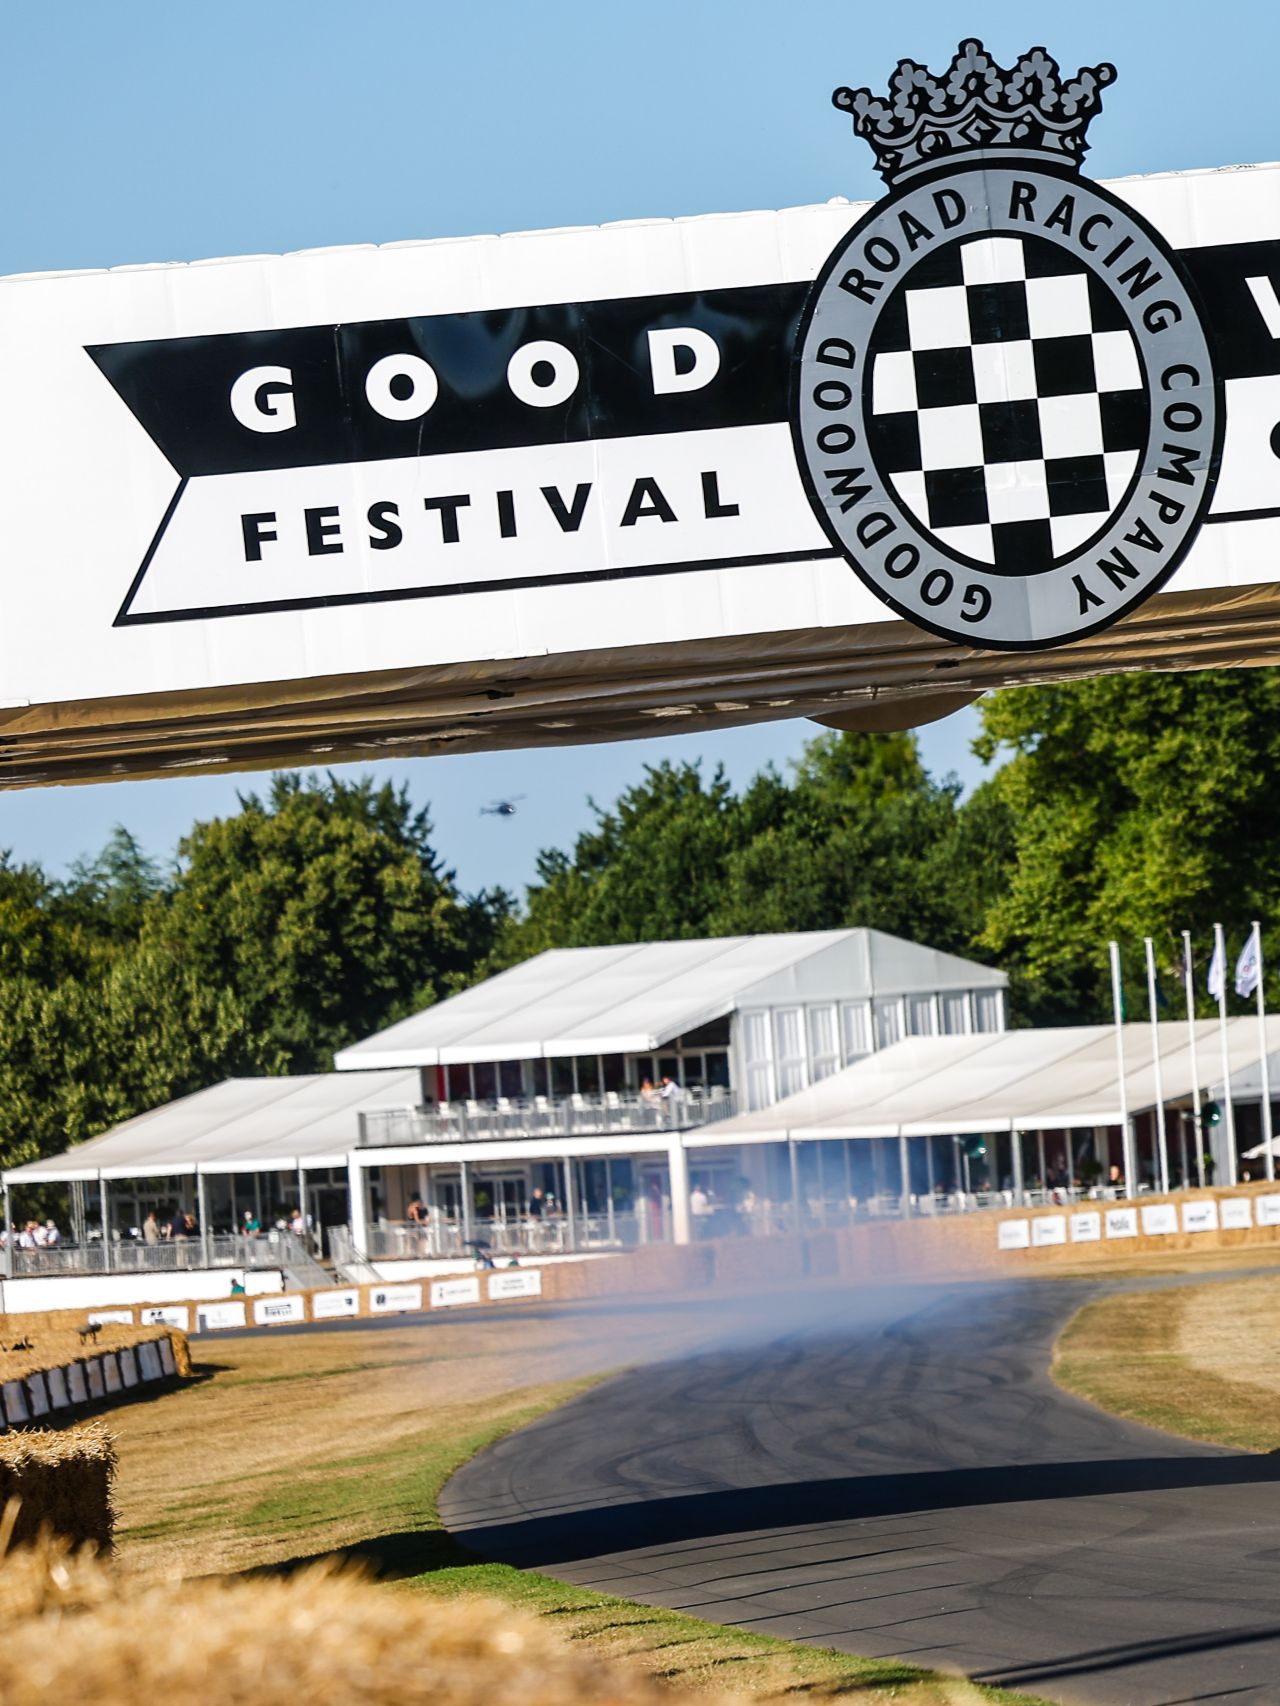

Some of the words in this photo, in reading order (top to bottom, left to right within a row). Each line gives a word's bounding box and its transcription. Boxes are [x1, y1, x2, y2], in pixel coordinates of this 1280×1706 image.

[838, 188, 967, 305] ROAD
[1008, 180, 1182, 335] RACING
[230, 327, 720, 433] GOOD
[240, 470, 740, 562] FESTIVAL
[813, 337, 992, 622] GOODWOOD
[1071, 363, 1203, 615] COMPANY
